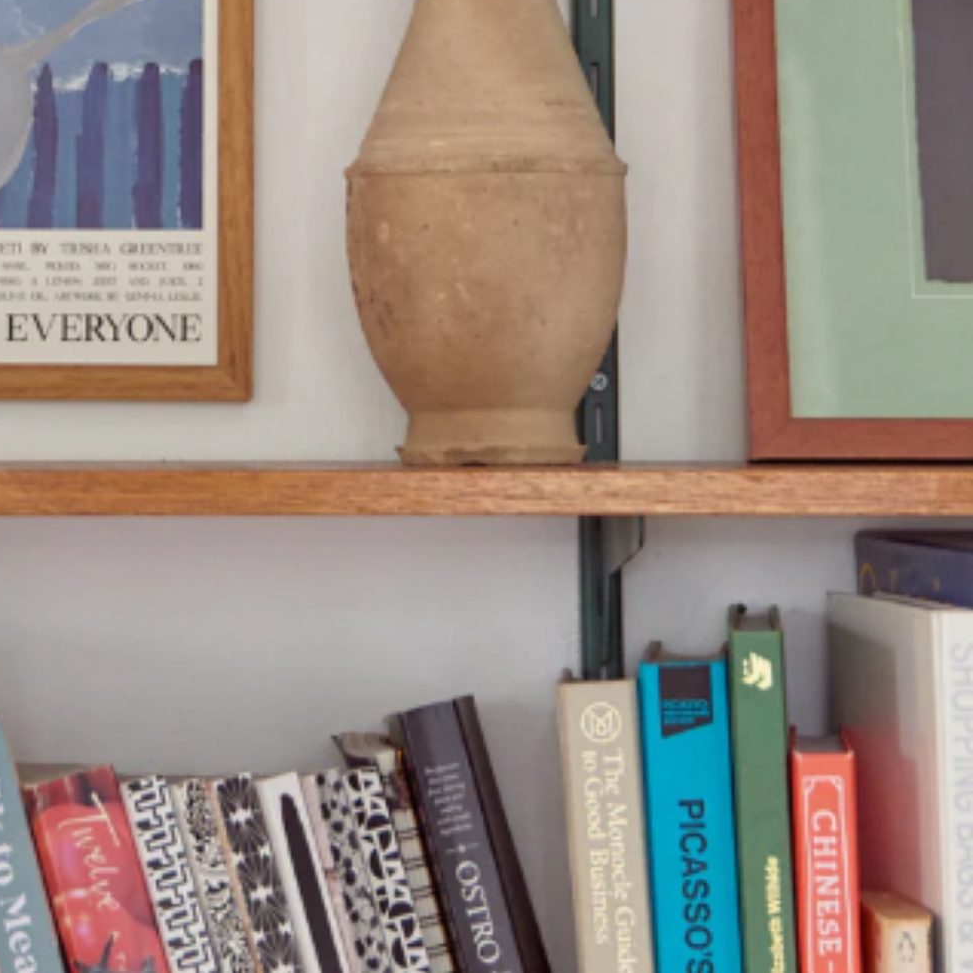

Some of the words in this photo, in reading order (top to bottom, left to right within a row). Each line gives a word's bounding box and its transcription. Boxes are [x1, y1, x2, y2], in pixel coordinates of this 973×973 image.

[5, 312, 203, 343] EVERYONE
[581, 749, 598, 771] to
[583, 775, 610, 840] Good
[602, 747, 624, 795] The
[57, 791, 121, 911] Twelve
[588, 848, 614, 945] Business
[606, 802, 632, 900] Monocle
[678, 798, 715, 973] PICASSO'S
[811, 808, 843, 956] CHINESE
[455, 860, 501, 964] OSTRO
[614, 906, 639, 973] Guide
